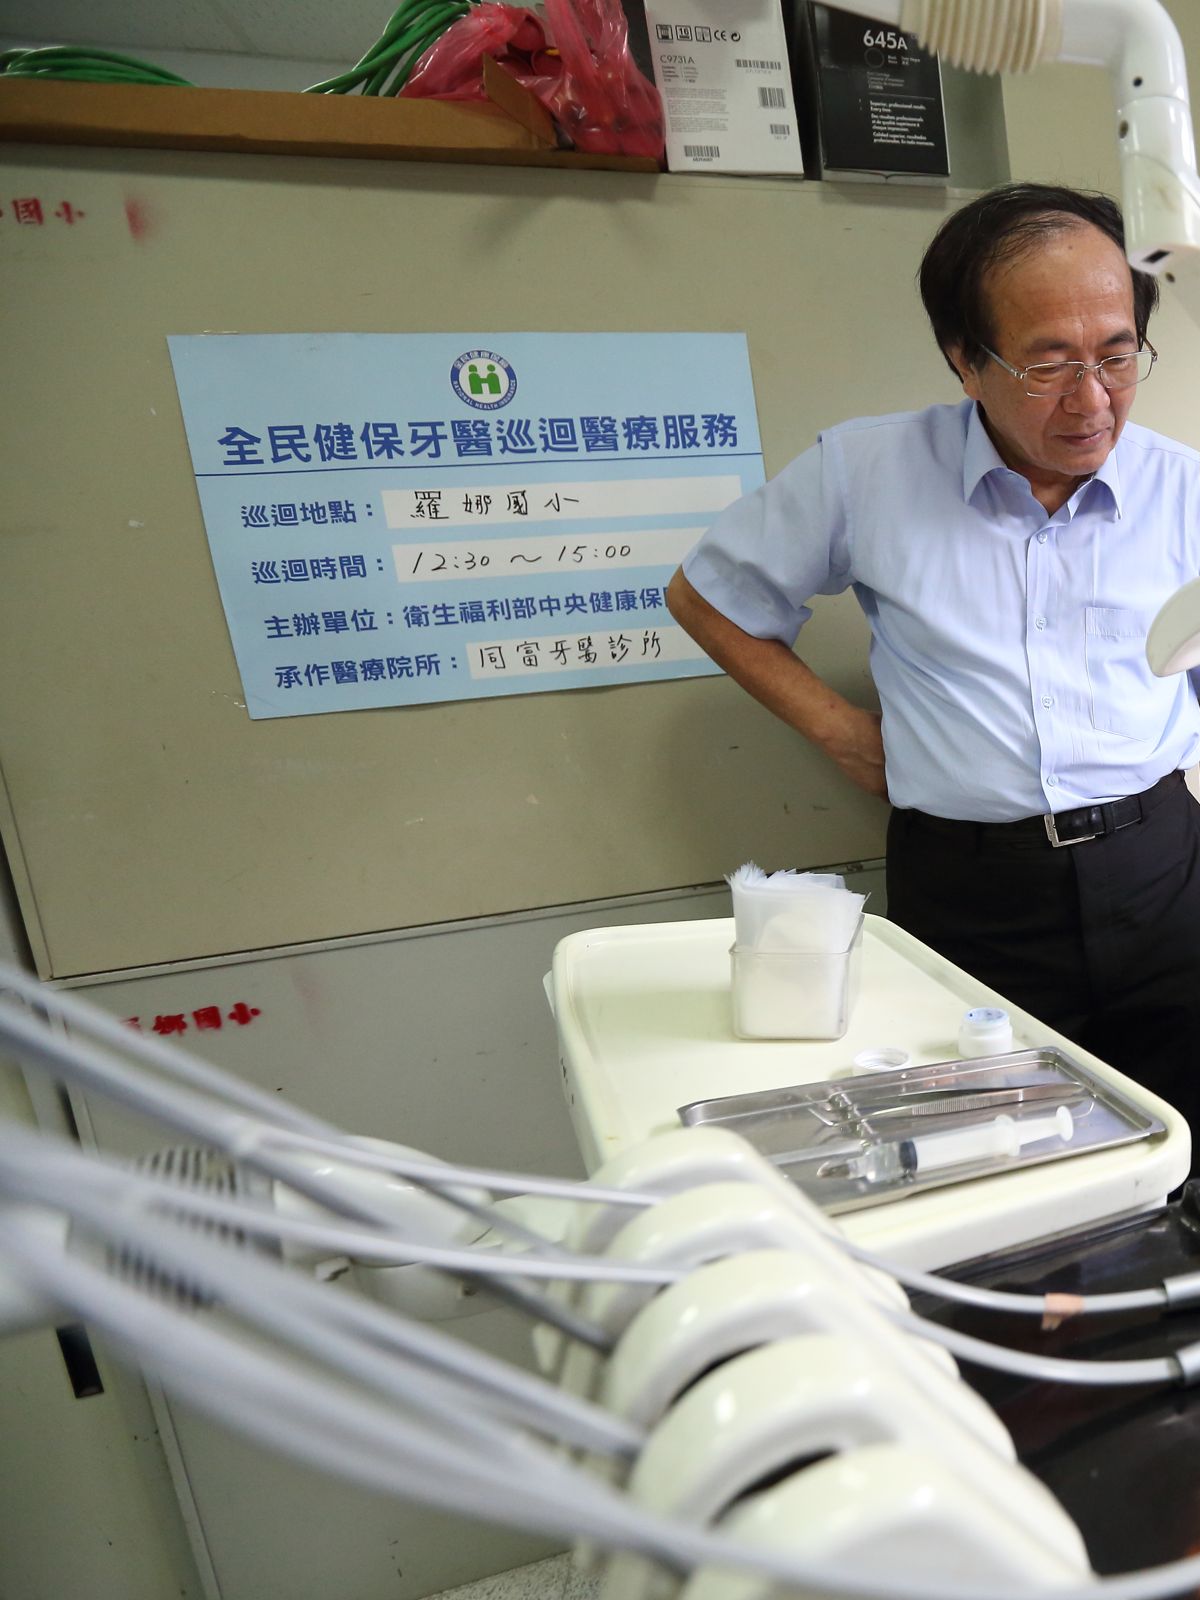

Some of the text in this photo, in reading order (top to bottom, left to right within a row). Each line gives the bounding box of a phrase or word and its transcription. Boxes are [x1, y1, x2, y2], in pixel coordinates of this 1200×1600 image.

[863, 29, 908, 51] 645A
[660, 54, 696, 64] C9731A
[475, 402, 499, 411] HEALTH
[217, 412, 738, 466] 全民健保牙醫巡迴醫療服務
[241, 500, 373, 528] 巡迴地點：
[251, 555, 384, 584] 巡迴時間：
[264, 587, 668, 639] 主辦單位：衛生福利部中央健康保
[275, 653, 458, 689] 承作醫療院所：
